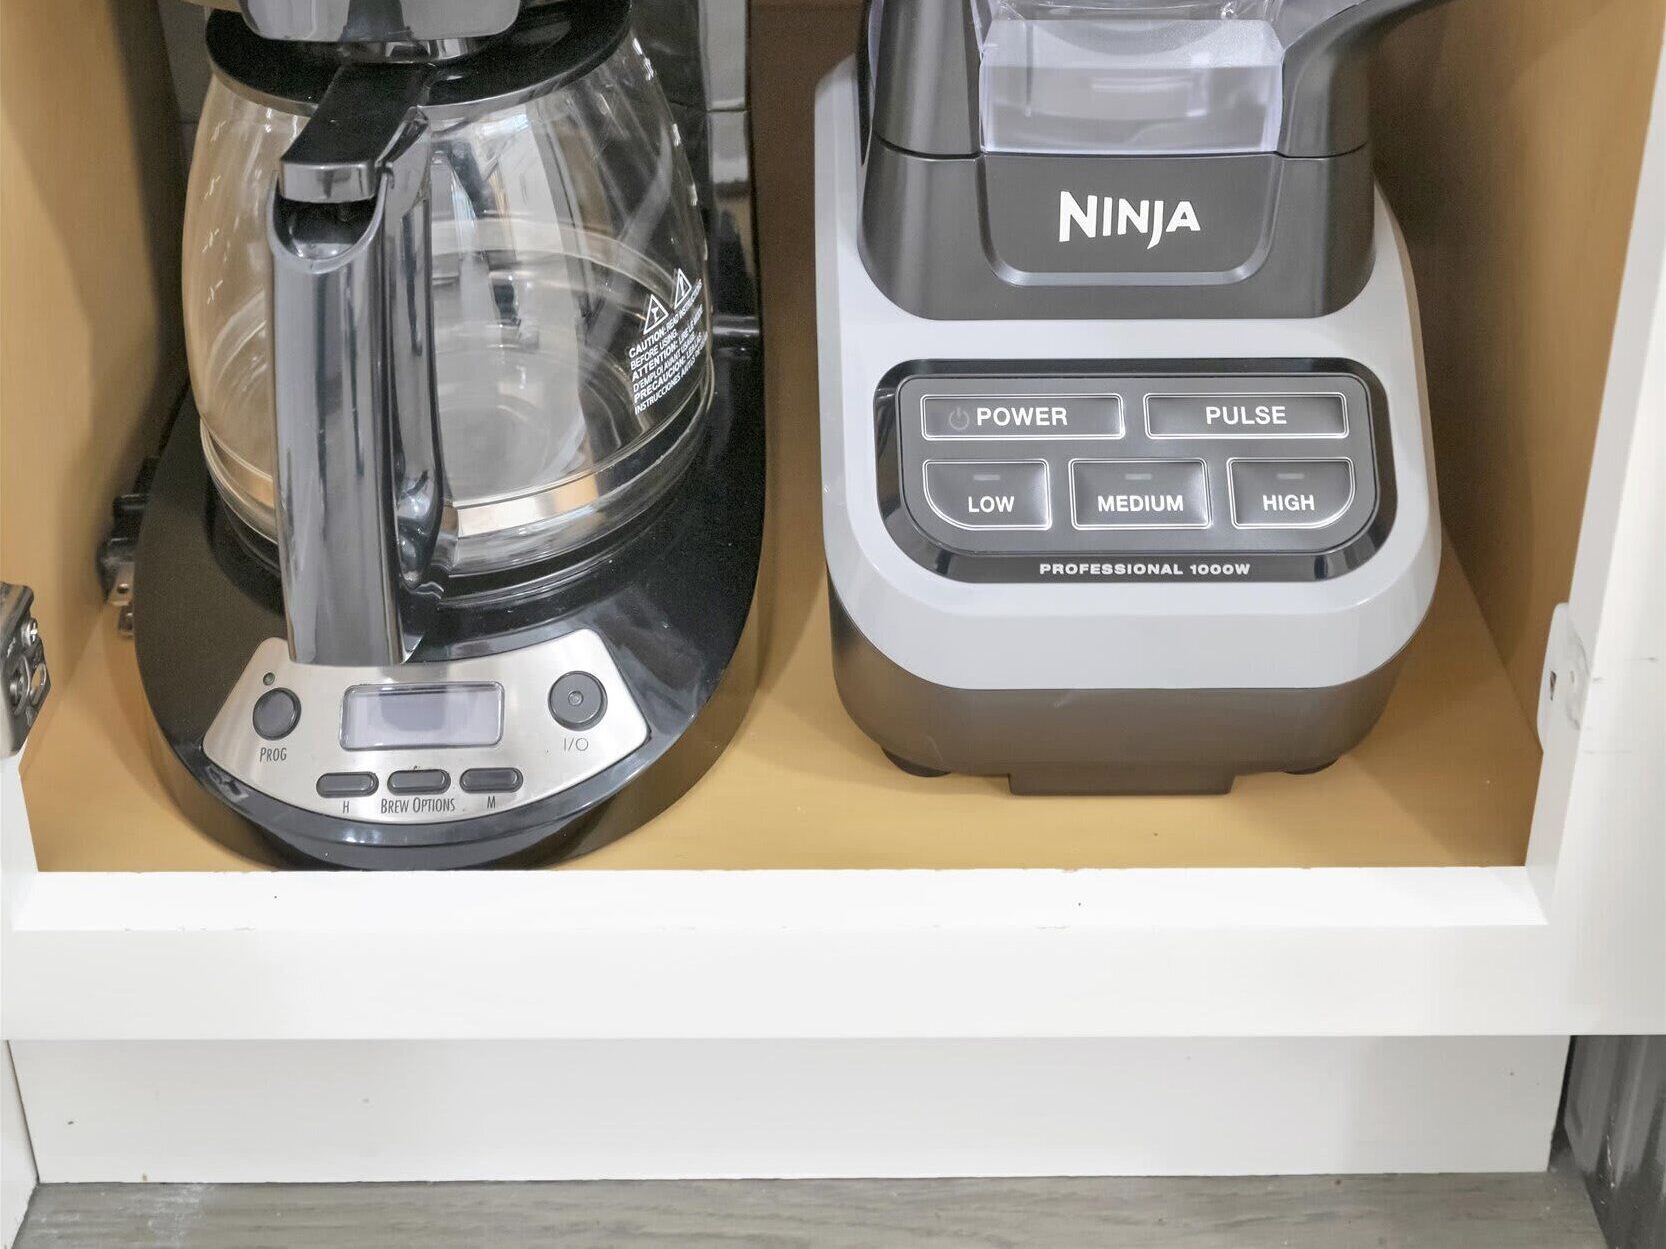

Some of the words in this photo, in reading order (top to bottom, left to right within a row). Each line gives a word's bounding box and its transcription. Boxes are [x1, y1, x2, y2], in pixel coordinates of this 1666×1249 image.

[1059, 191, 1201, 250] NINJA
[629, 329, 667, 358] CAUTION:
[630, 346, 659, 371] BEFORE
[632, 340, 679, 383] ATTENTION:
[634, 375, 681, 415] INSTRUCCIONES
[976, 407, 1068, 426] POWER
[1205, 406, 1288, 425] PULSE
[967, 497, 1015, 513] LOW
[1097, 495, 1184, 512] MEDIUM
[1262, 494, 1316, 512] HIGH
[1039, 563, 1184, 576] PROFESSIONAL
[1189, 562, 1251, 576] 1000W
[259, 747, 287, 763] PROG
[342, 800, 350, 813] H
[380, 798, 409, 814] BREW
[412, 796, 456, 813] OPTIONS
[486, 795, 496, 809] M
